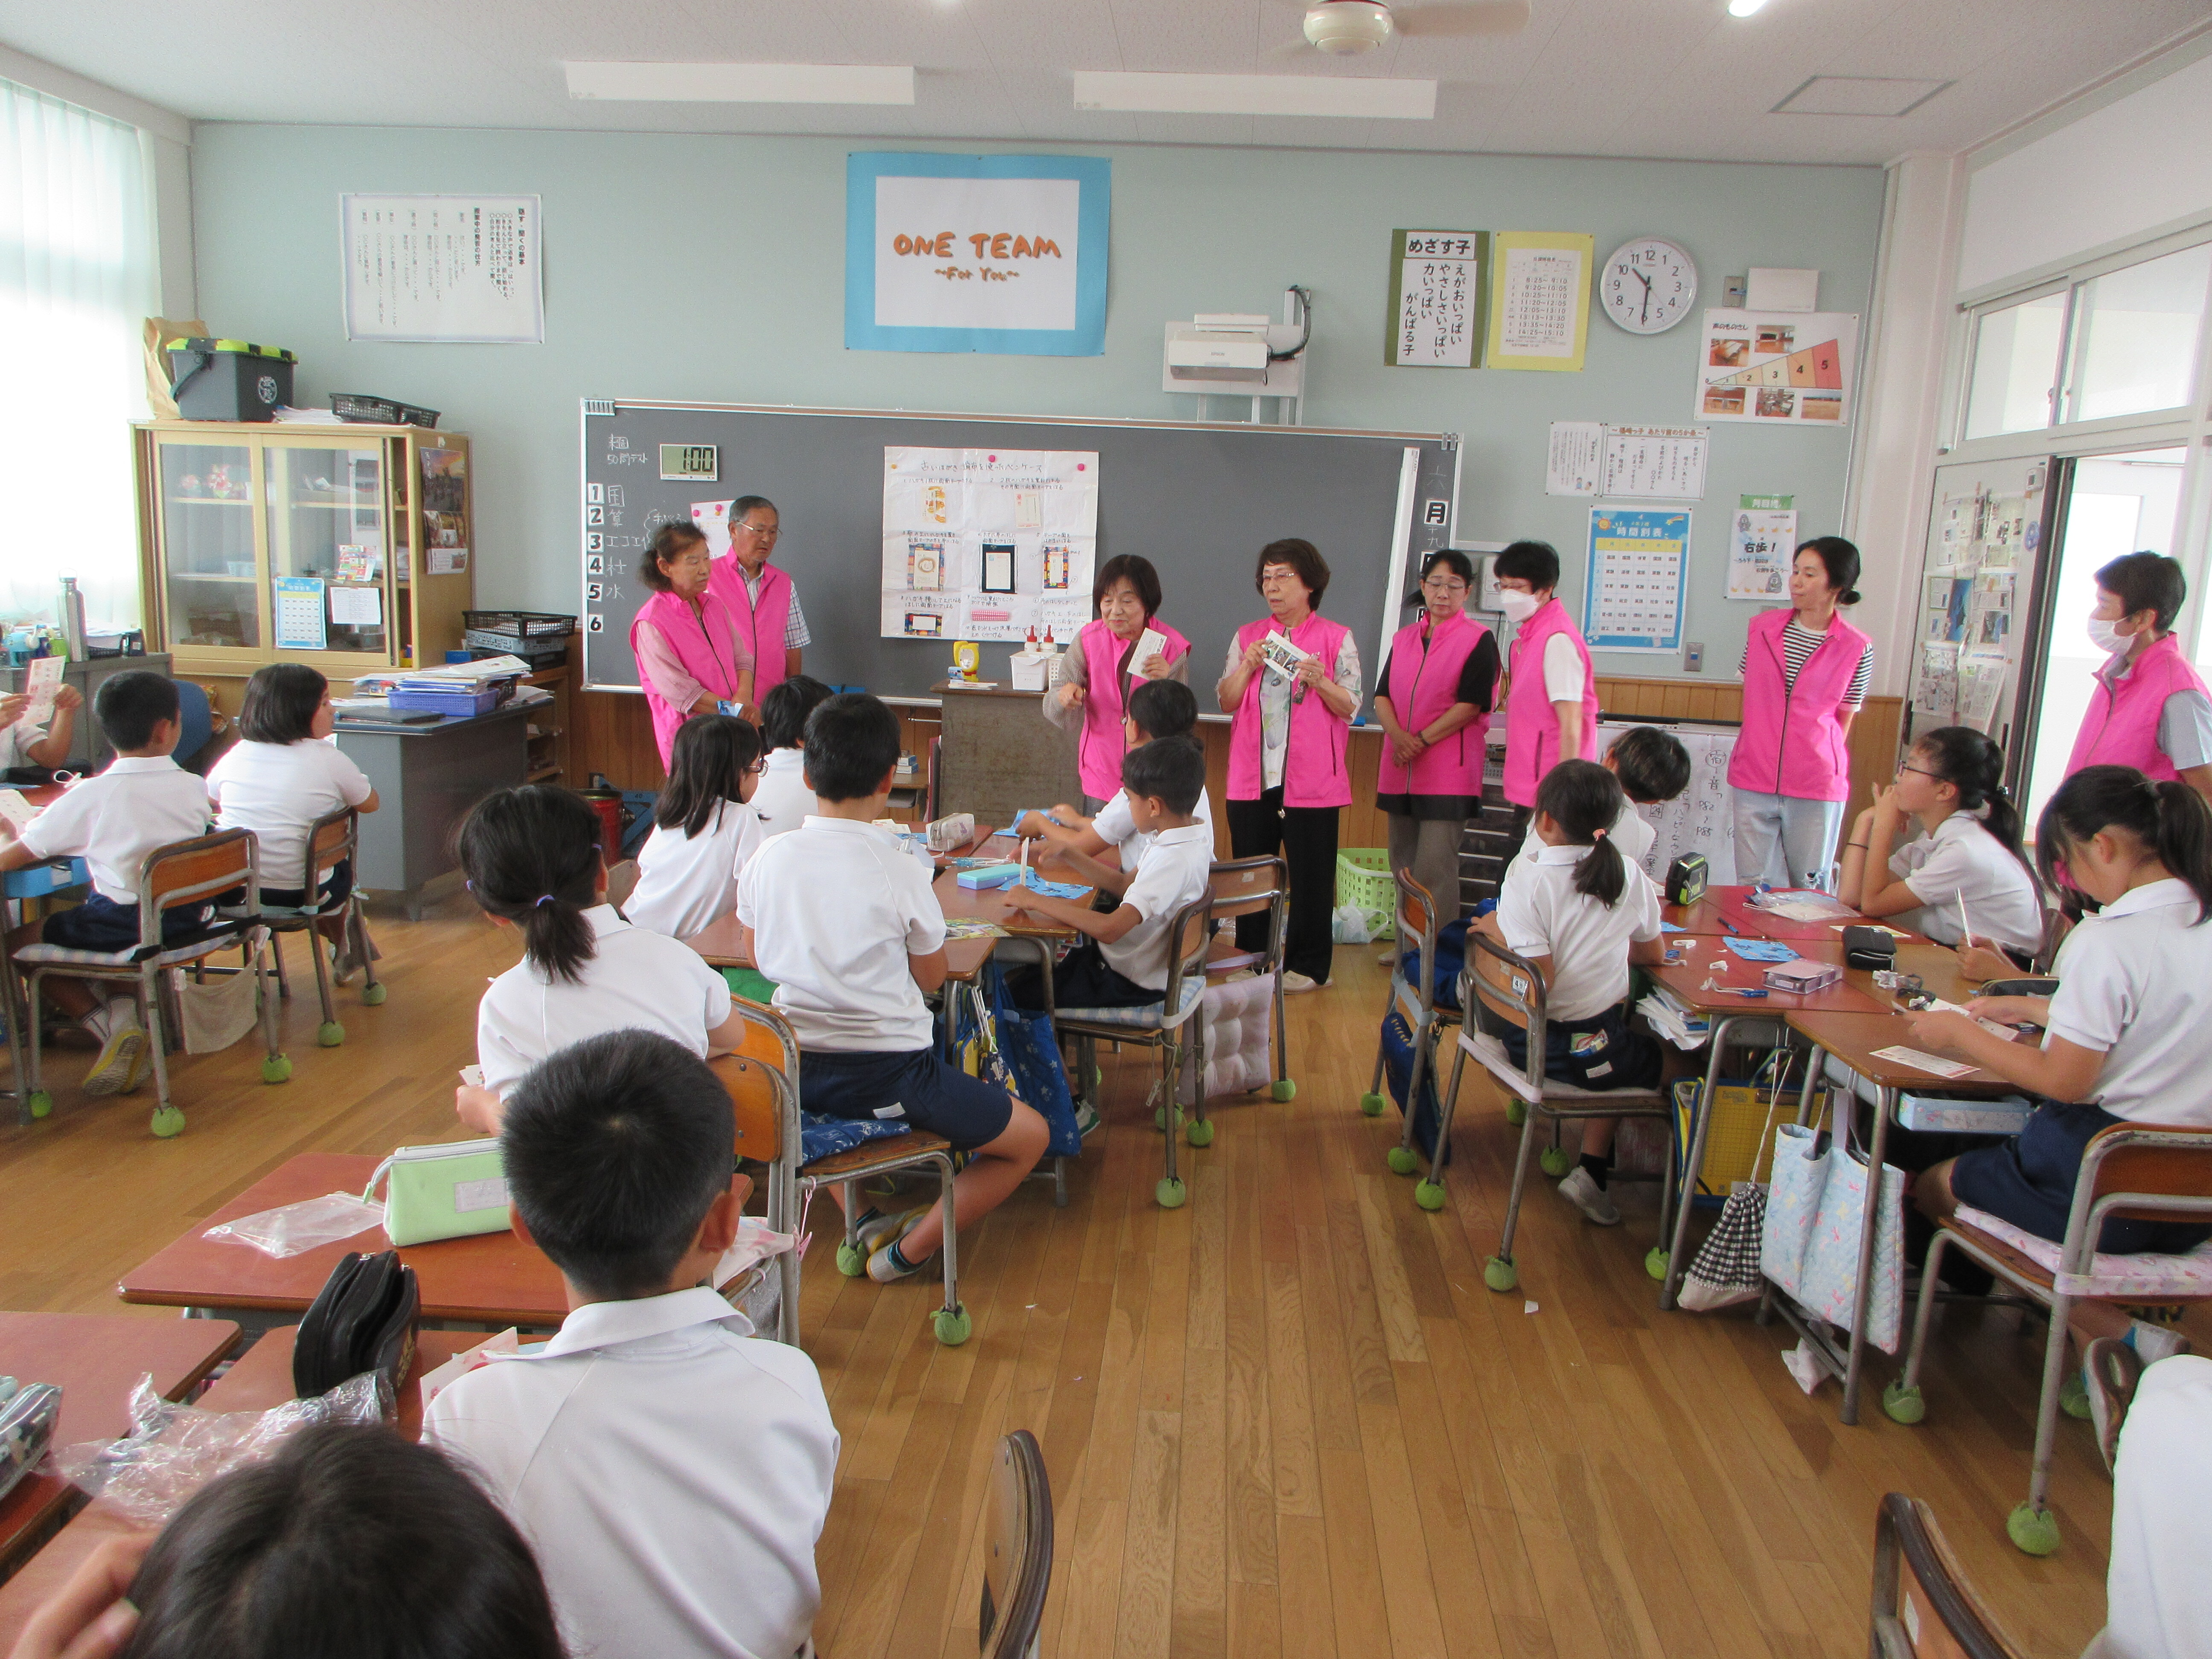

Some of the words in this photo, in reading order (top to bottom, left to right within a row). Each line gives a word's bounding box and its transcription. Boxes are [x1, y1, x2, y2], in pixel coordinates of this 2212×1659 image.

[894, 232, 956, 258] ONE
[968, 233, 1061, 259] TEAM
[1409, 238, 1470, 254] めざす子
[1631, 254, 1639, 264] 11
[1645, 250, 1656, 260] 12
[1662, 255, 1667, 265] 1
[1618, 265, 1628, 275] 10
[1672, 266, 1679, 276] 2
[1421, 263, 1435, 319] 力いっぱい
[1613, 280, 1620, 290] 9
[1674, 282, 1682, 292] 3
[1451, 264, 1465, 345] えがおいっぱい
[1616, 296, 1623, 306] 8
[1668, 297, 1676, 307] 4
[1435, 264, 1451, 358] やさしさいっぱい
[1627, 307, 1634, 317] 7
[1656, 308, 1663, 318] 5
[1403, 293, 1419, 355] がんばる子
[1796, 365, 1805, 373] 4
[1822, 360, 1828, 370] 5
[683, 448, 713, 472] 1:00
[593, 486, 598, 501] 1
[608, 485, 625, 507] 国
[591, 508, 601, 524] 2
[590, 535, 600, 549] 3
[590, 557, 601, 572] 4
[606, 556, 627, 576] 社
[589, 585, 600, 599] 5
[606, 584, 625, 600] 水
[591, 617, 602, 631] 6
